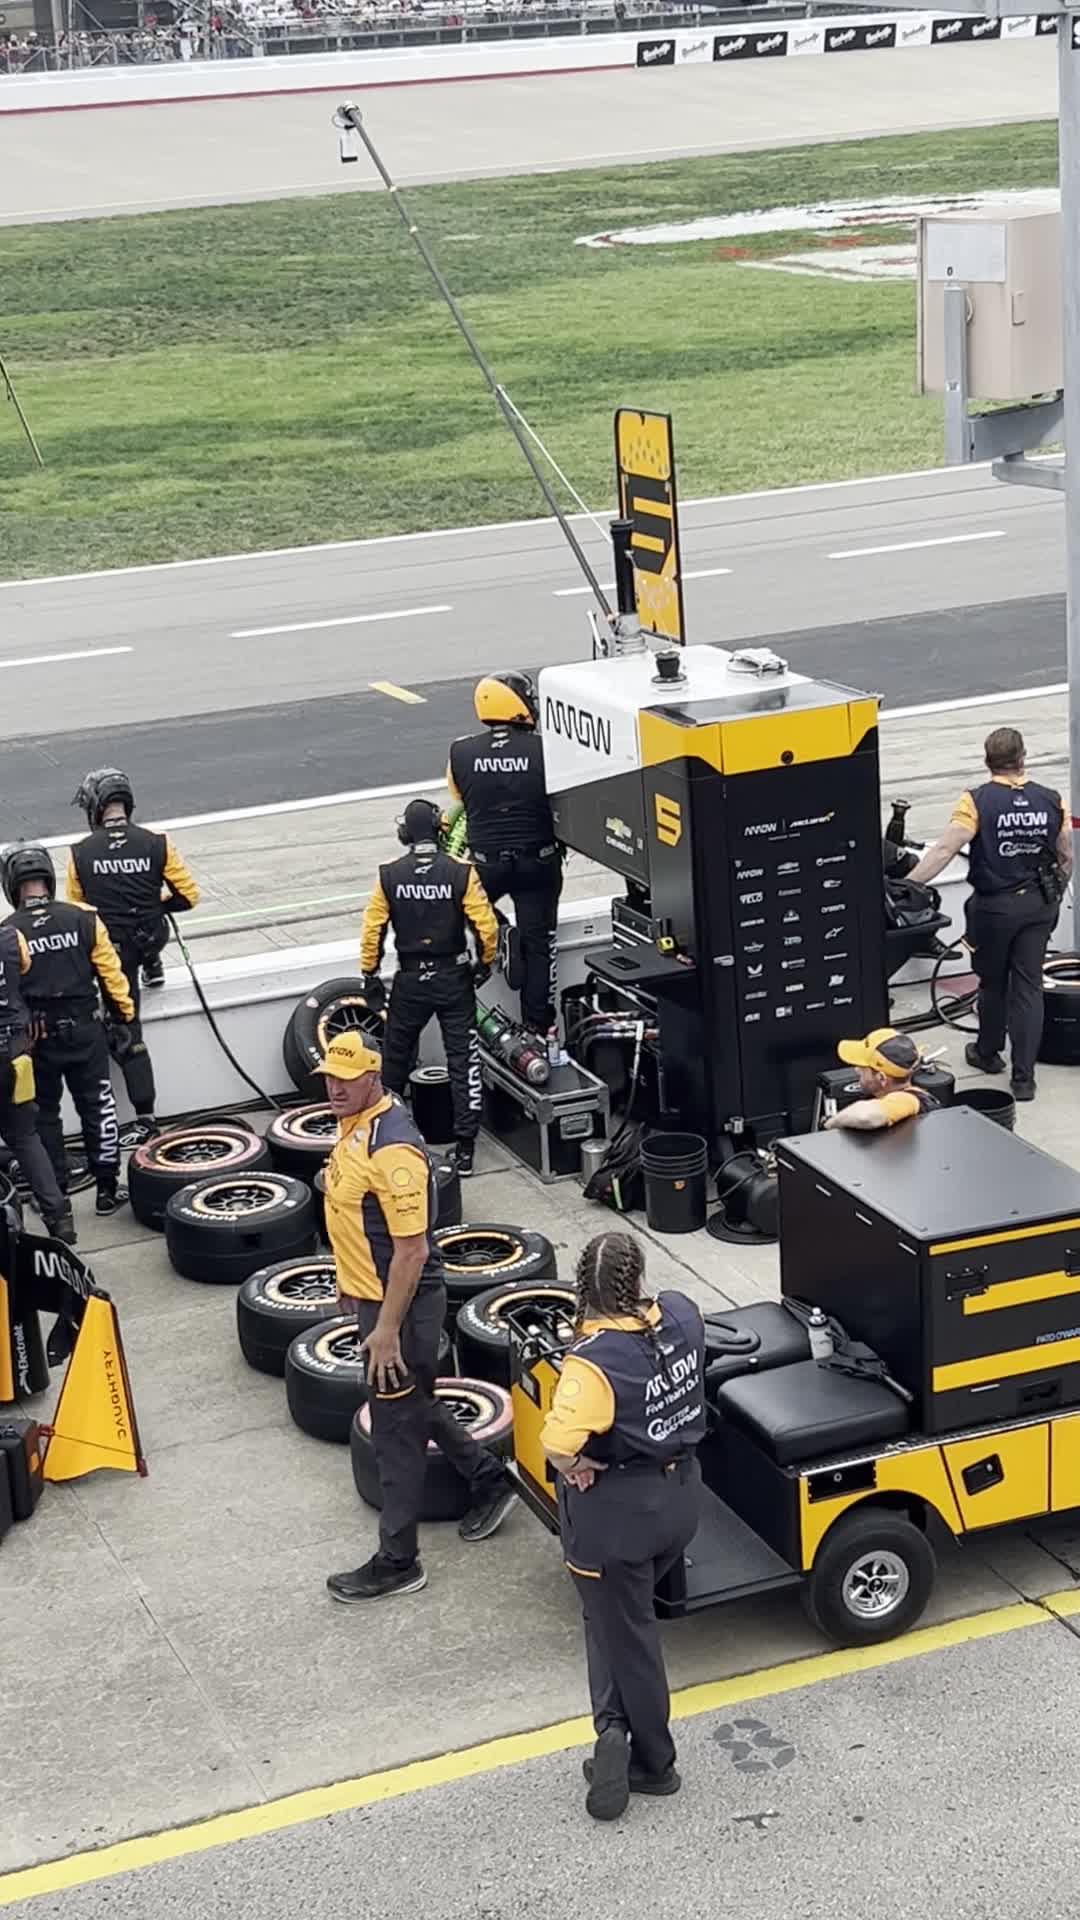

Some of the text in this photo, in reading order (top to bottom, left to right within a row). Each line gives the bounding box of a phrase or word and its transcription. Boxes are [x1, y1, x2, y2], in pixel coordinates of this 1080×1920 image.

[546, 695, 611, 756] ARROW
[474, 757, 529, 772] ARROW
[654, 792, 682, 848] 5
[997, 812, 1048, 828] ARROW
[744, 823, 777, 836] ARROW
[93, 857, 150, 874] ARROW
[396, 883, 451, 899] ARROW
[99, 1079, 119, 1163] ARROW
